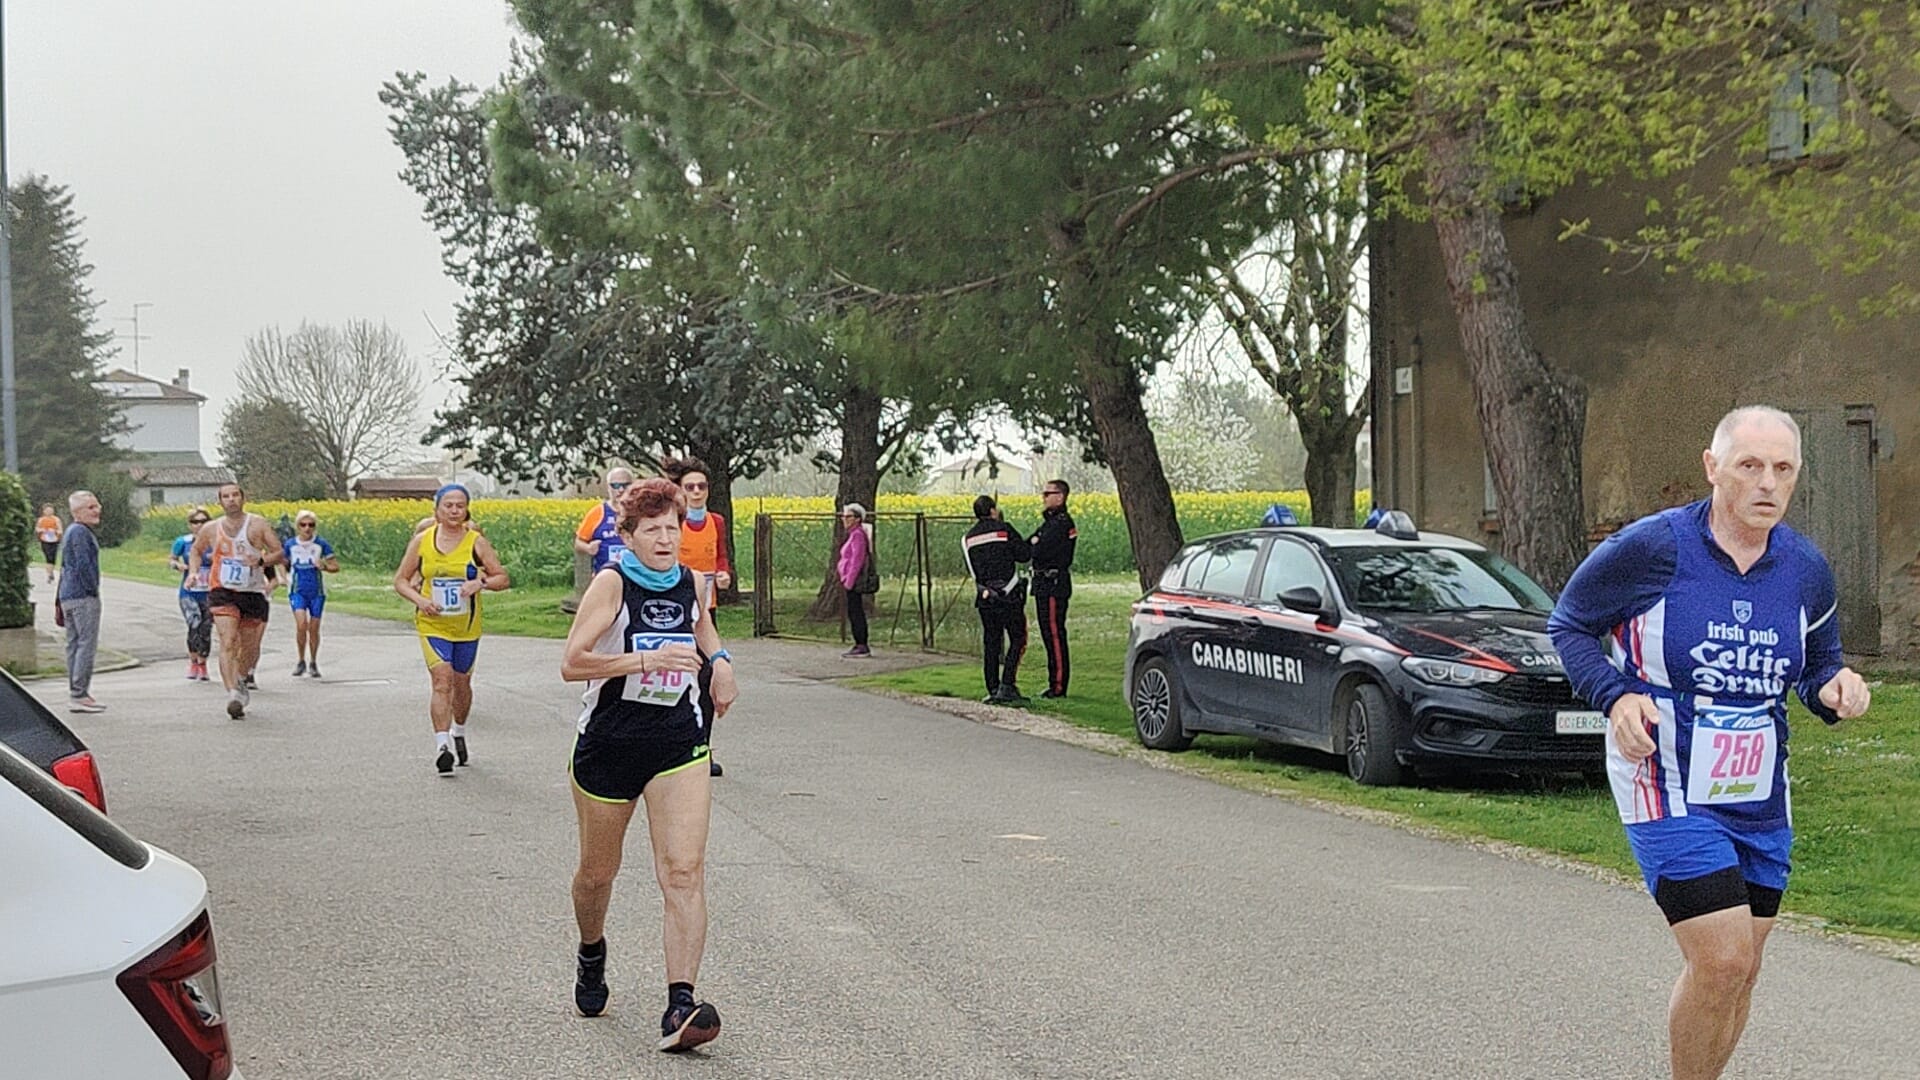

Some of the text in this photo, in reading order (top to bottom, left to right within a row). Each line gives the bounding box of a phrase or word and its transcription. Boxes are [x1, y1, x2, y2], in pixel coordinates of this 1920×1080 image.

[229, 566, 243, 582] 72
[444, 588, 459, 606] 15
[1749, 628, 1779, 647] pub
[1192, 641, 1304, 684] CARABINIERI
[1689, 640, 1791, 676] Celtic
[1710, 732, 1765, 779] 258
